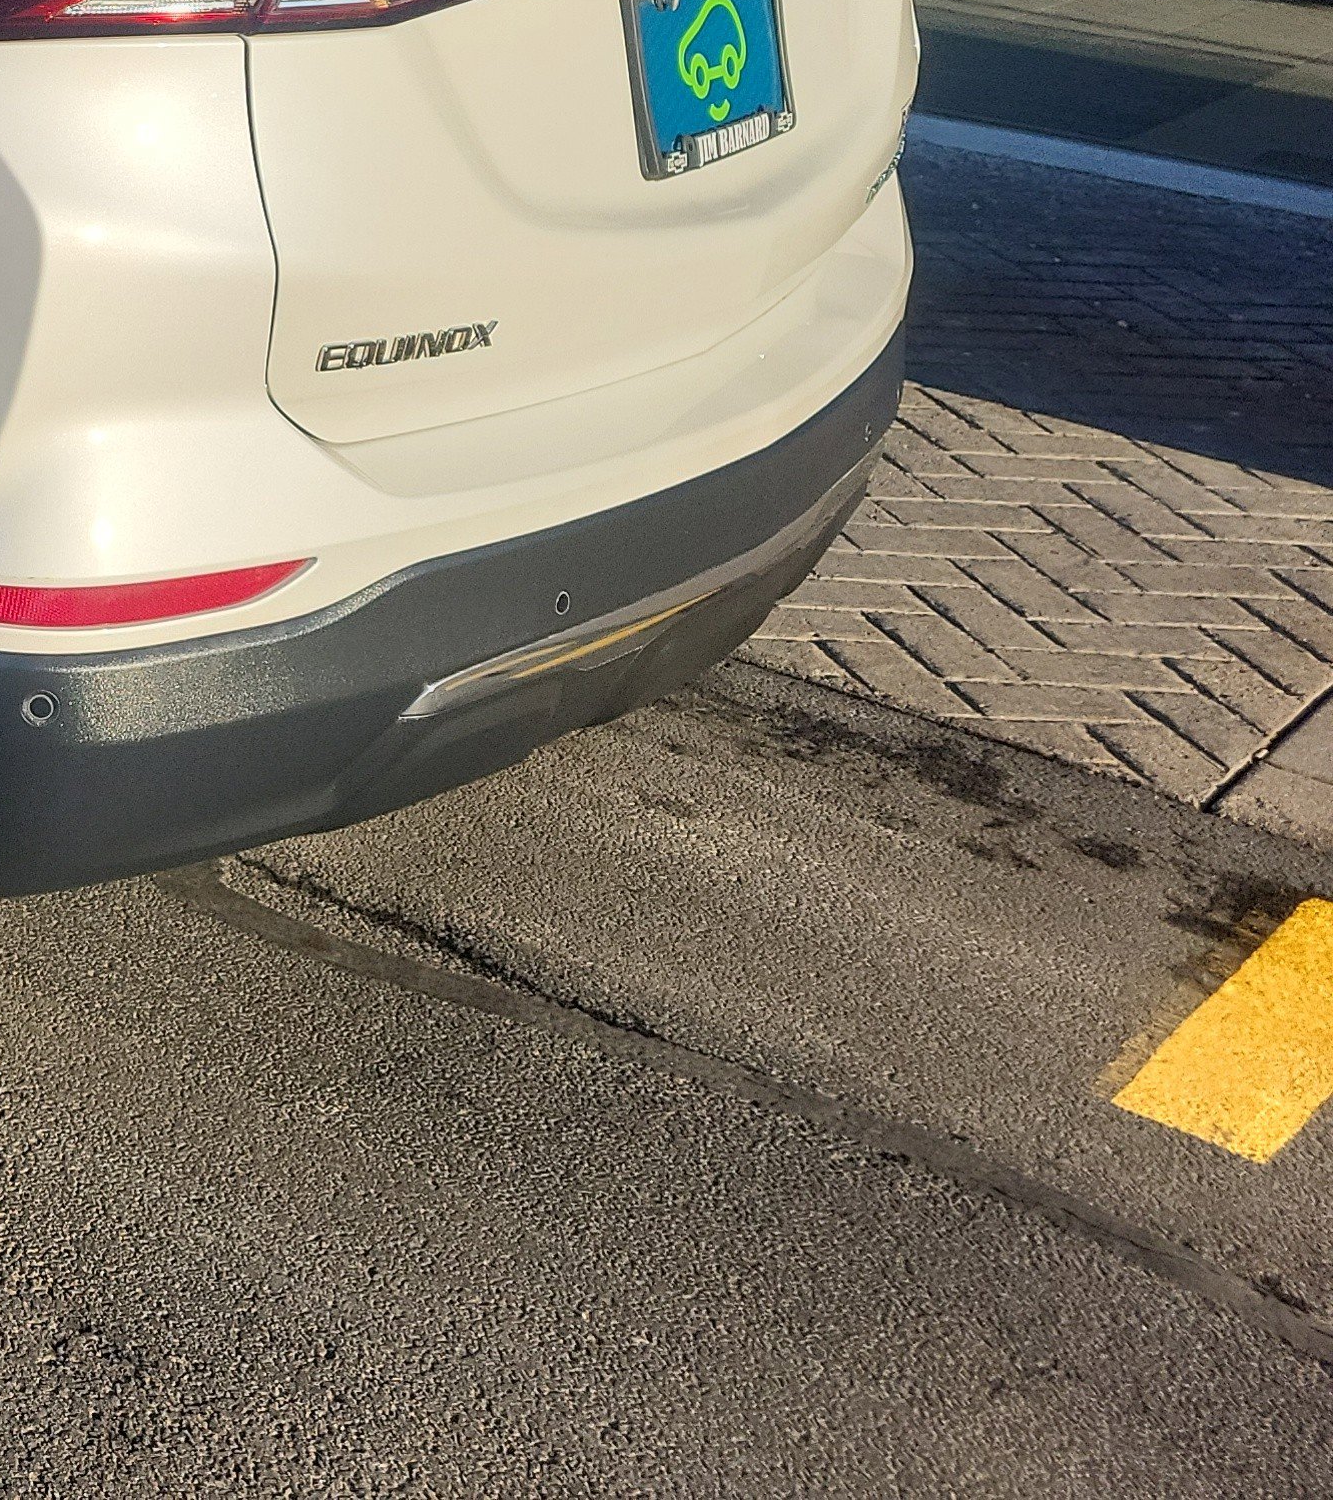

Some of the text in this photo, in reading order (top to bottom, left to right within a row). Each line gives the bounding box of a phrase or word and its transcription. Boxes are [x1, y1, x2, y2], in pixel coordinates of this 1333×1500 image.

[696, 112, 771, 168] JIM BARNARD
[314, 319, 500, 372] EQUINOX
